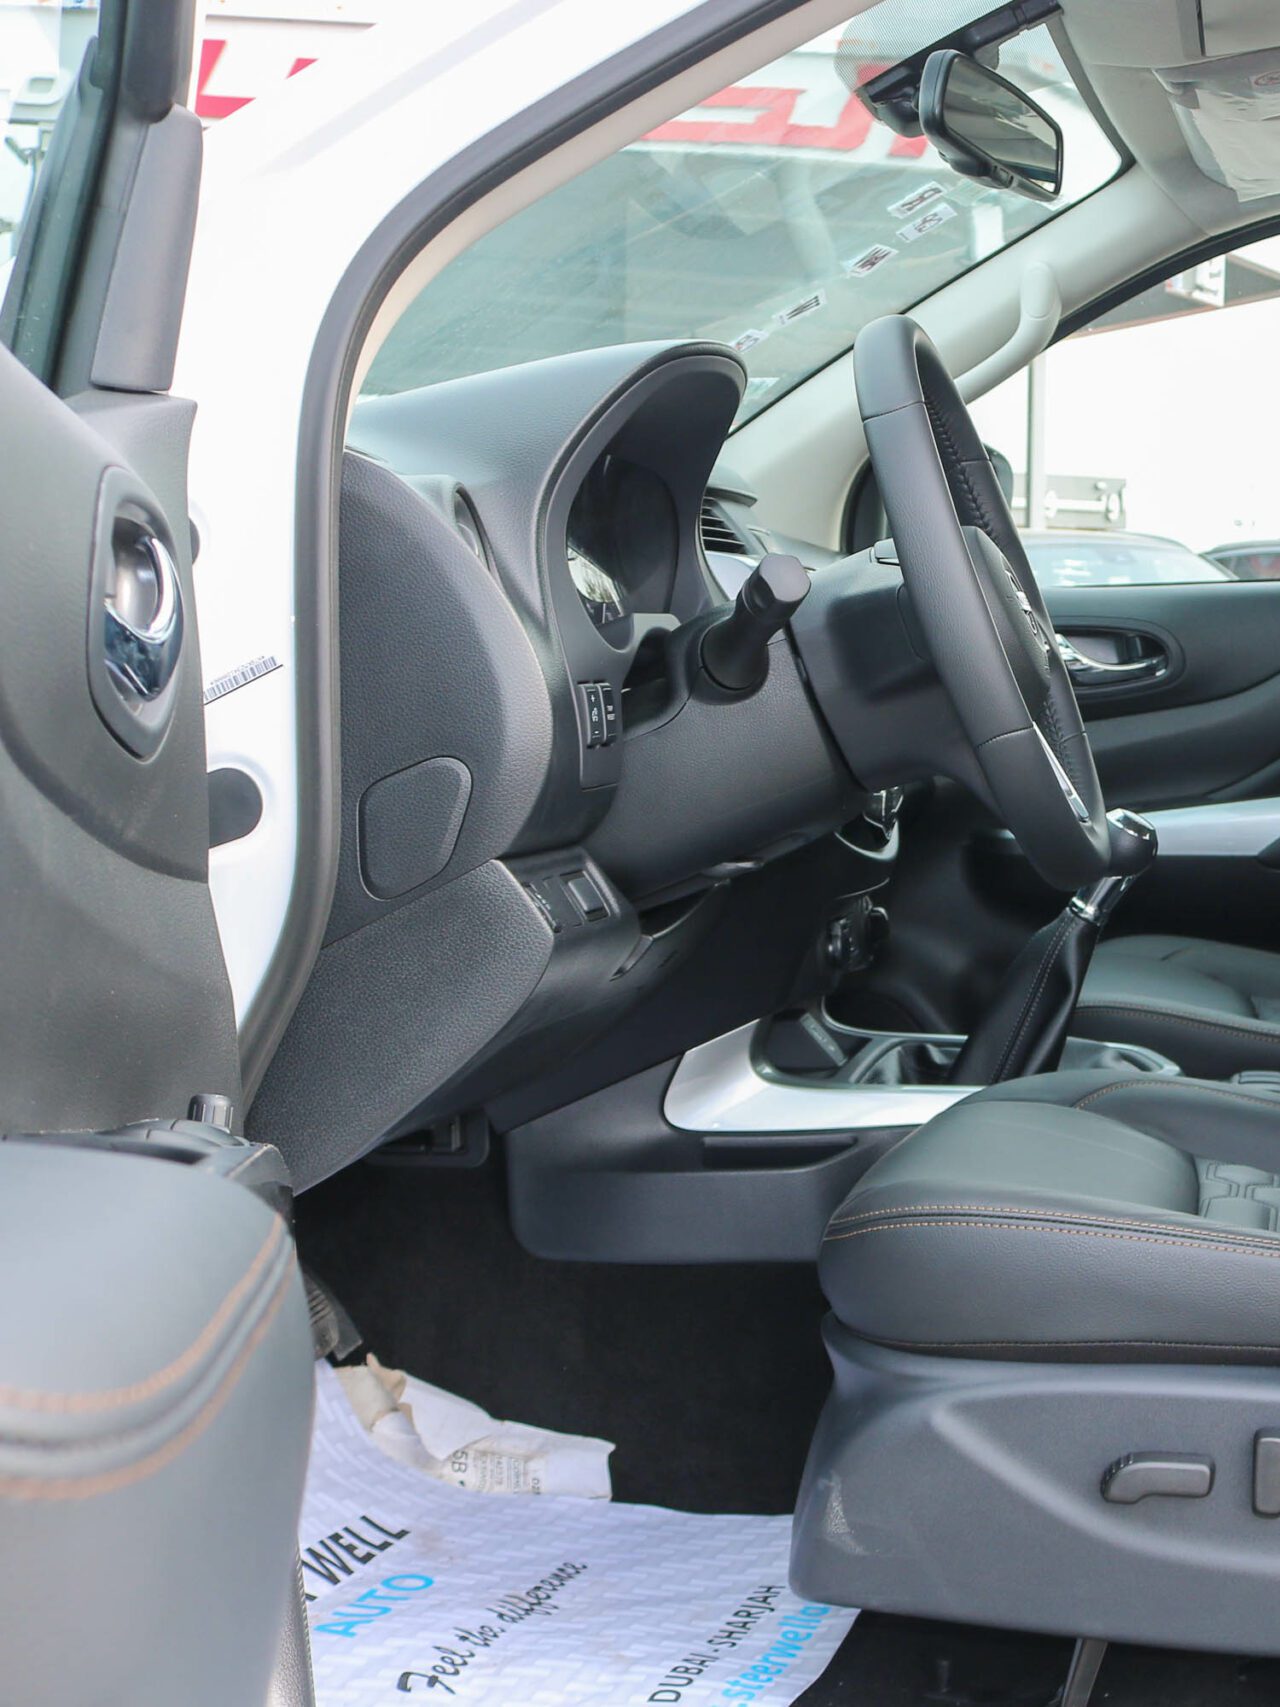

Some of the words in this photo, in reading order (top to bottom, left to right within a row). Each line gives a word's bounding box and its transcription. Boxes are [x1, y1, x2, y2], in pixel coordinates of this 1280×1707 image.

[301, 1515, 411, 1601] WELL
[313, 1574, 434, 1638] AUTO
[397, 1645, 475, 1695] Feel
